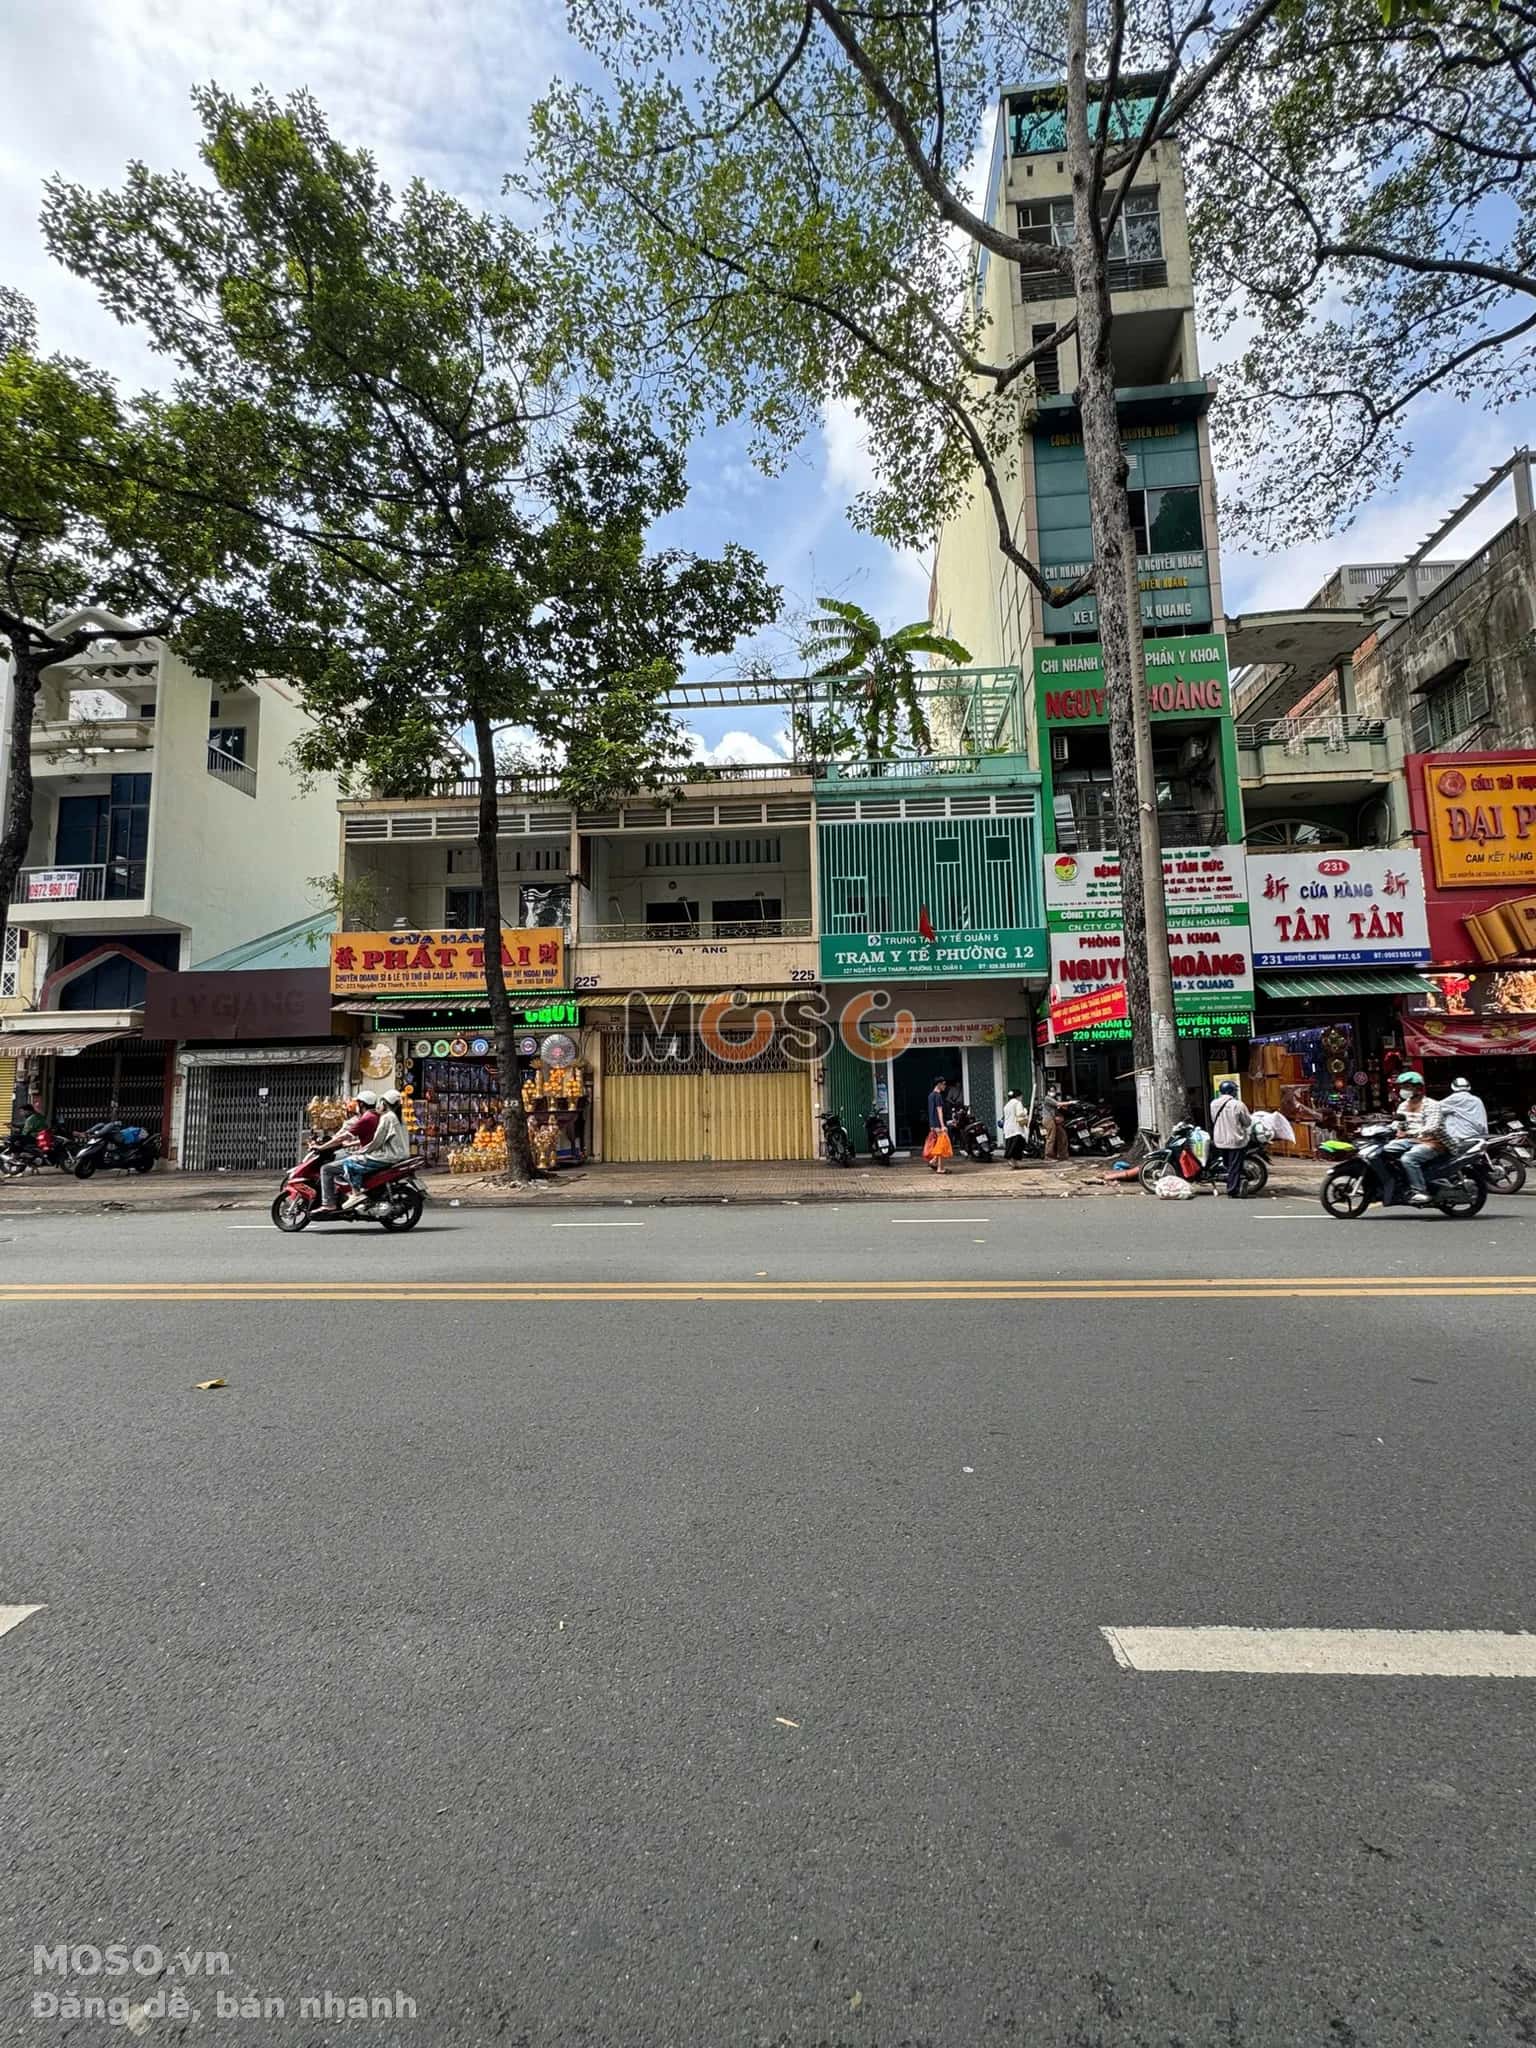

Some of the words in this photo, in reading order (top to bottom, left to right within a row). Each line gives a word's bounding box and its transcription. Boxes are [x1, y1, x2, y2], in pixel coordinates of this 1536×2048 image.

[1155, 602, 1192, 618] QUANG
[1041, 659, 1059, 674] CHI
[1063, 655, 1098, 672] NHÁNH
[1146, 646, 1175, 666] PHẦN
[1179, 650, 1187, 663] Y
[1190, 648, 1221, 663] KHOA
[1045, 688, 1109, 720] NGUY
[1446, 804, 1506, 847] ĐẠI
[1323, 862, 1344, 872] 231
[1465, 853, 1485, 864] CAM
[1262, 873, 1290, 903] 新
[1300, 881, 1329, 899] CỬA
[1333, 881, 1374, 898] HÀNG
[1381, 869, 1410, 898] 新
[1274, 906, 1331, 942] TÂN
[1347, 903, 1404, 939] TÂN
[441, 932, 503, 944] HÀN
[884, 936, 916, 945] TRUNG
[941, 935, 947, 943] Y
[993, 933, 999, 942] 5
[1079, 934, 1121, 949] PHÒNG
[1187, 931, 1221, 944] KHOA
[362, 944, 458, 970] PHÁT
[834, 950, 885, 966] TRẠM
[890, 950, 901, 962] Y
[907, 944, 930, 962] TẾ
[935, 944, 1008, 961] PHƯỜNG
[1014, 945, 1034, 959] 12
[1261, 954, 1283, 966] 231
[791, 969, 815, 981] 225
[1060, 957, 1128, 982] NGUY
[1170, 950, 1246, 977] HOÀNG
[574, 976, 598, 988] 225
[1188, 981, 1195, 990] X
[1196, 979, 1234, 990] QUANG
